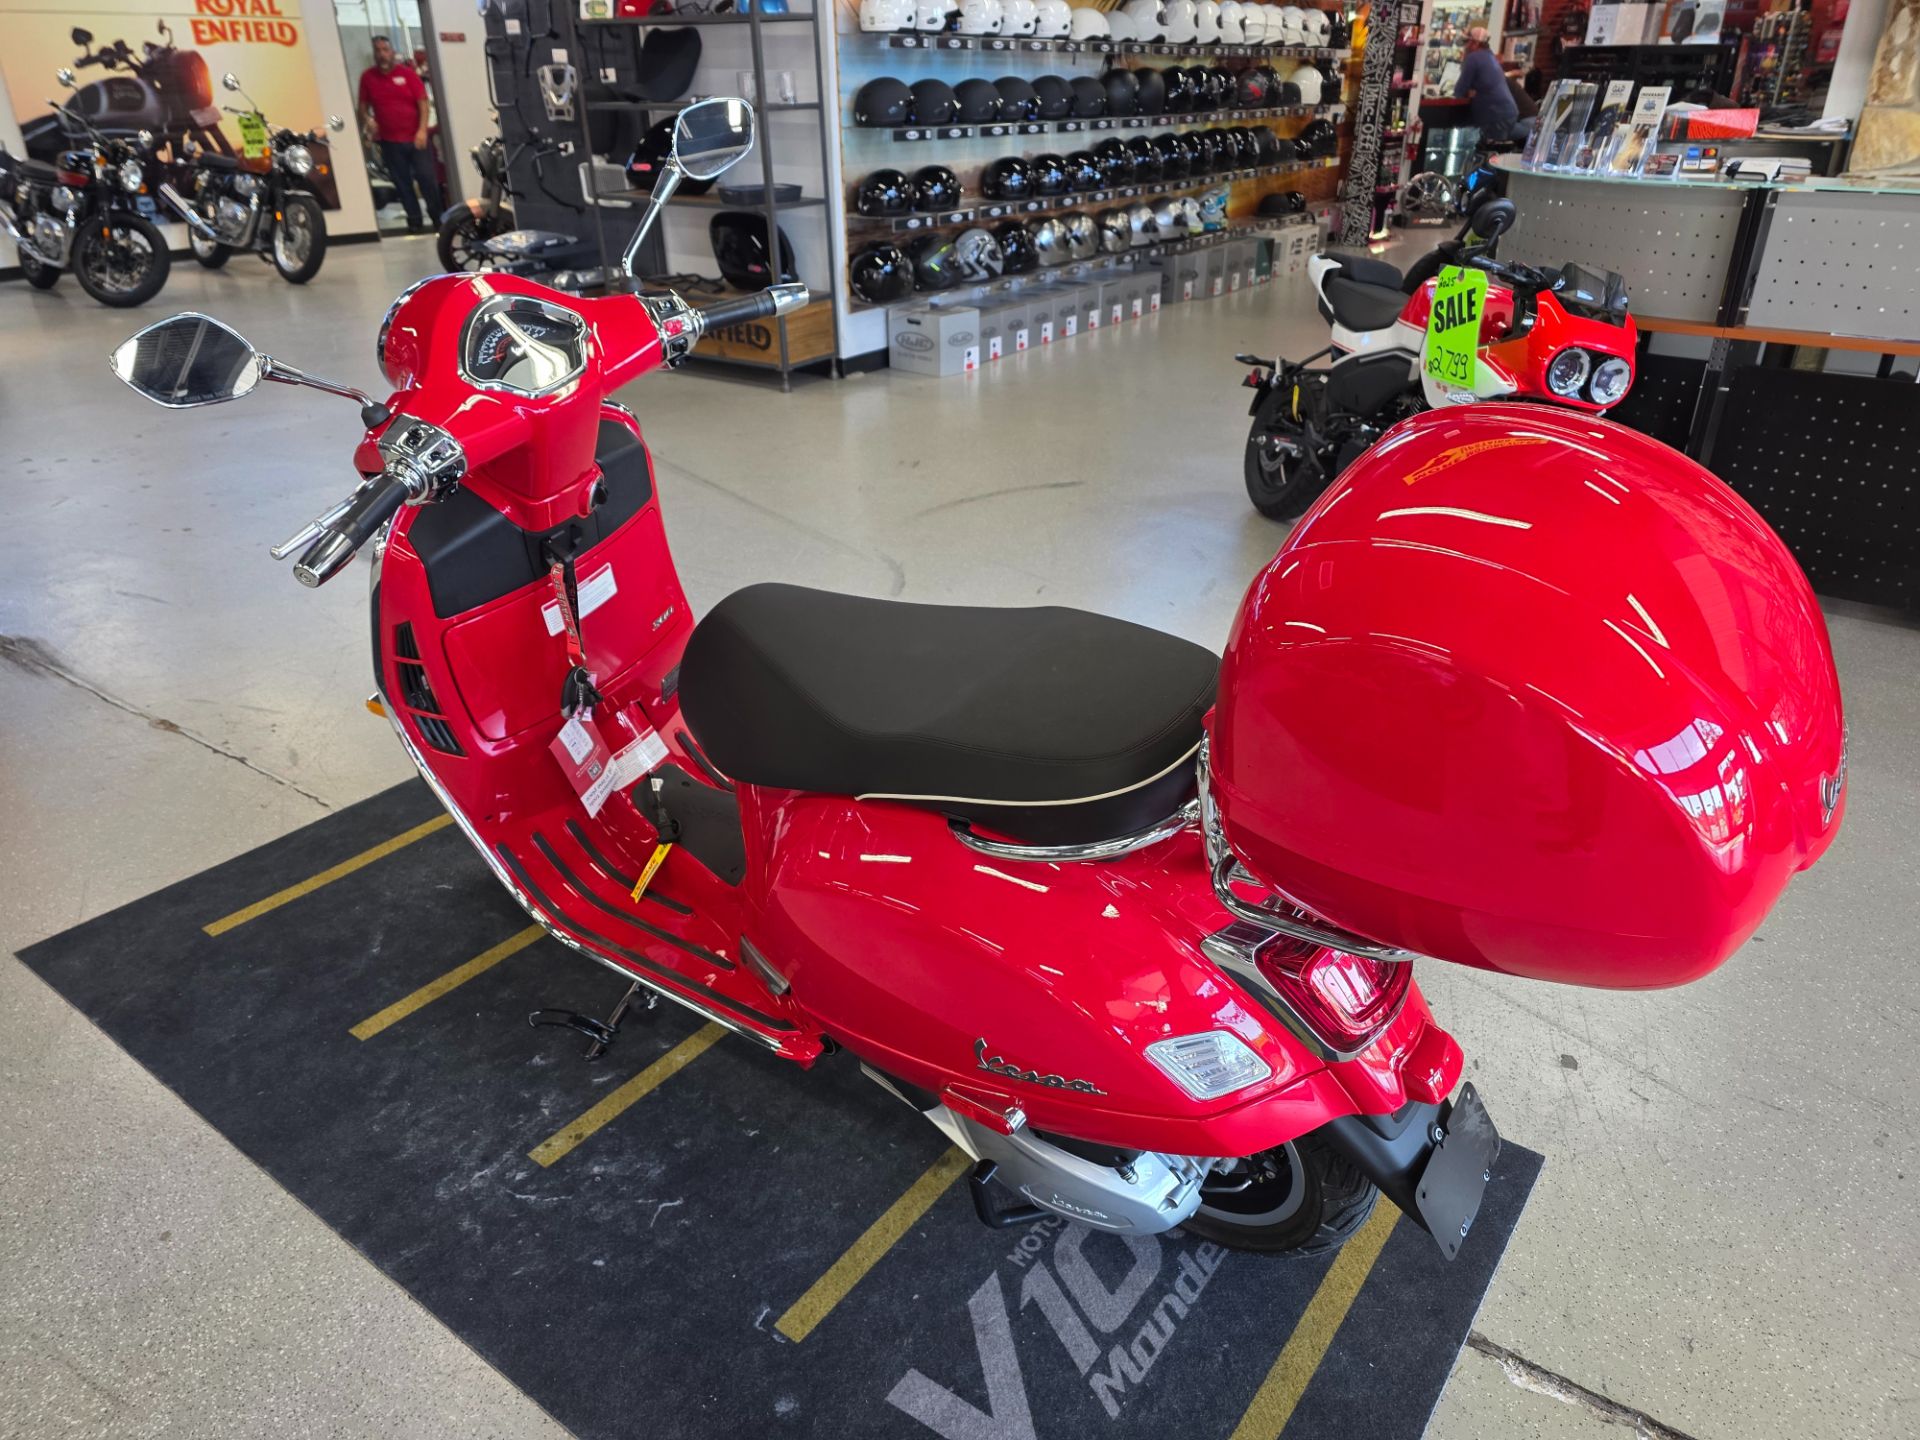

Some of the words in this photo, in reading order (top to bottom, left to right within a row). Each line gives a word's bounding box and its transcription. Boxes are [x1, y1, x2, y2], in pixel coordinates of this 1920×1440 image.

[194, 0, 283, 17] ROYAL
[190, 19, 298, 48] ENFIELD
[1433, 287, 1477, 334] SALE
[973, 1037, 1108, 1096] Vespa
